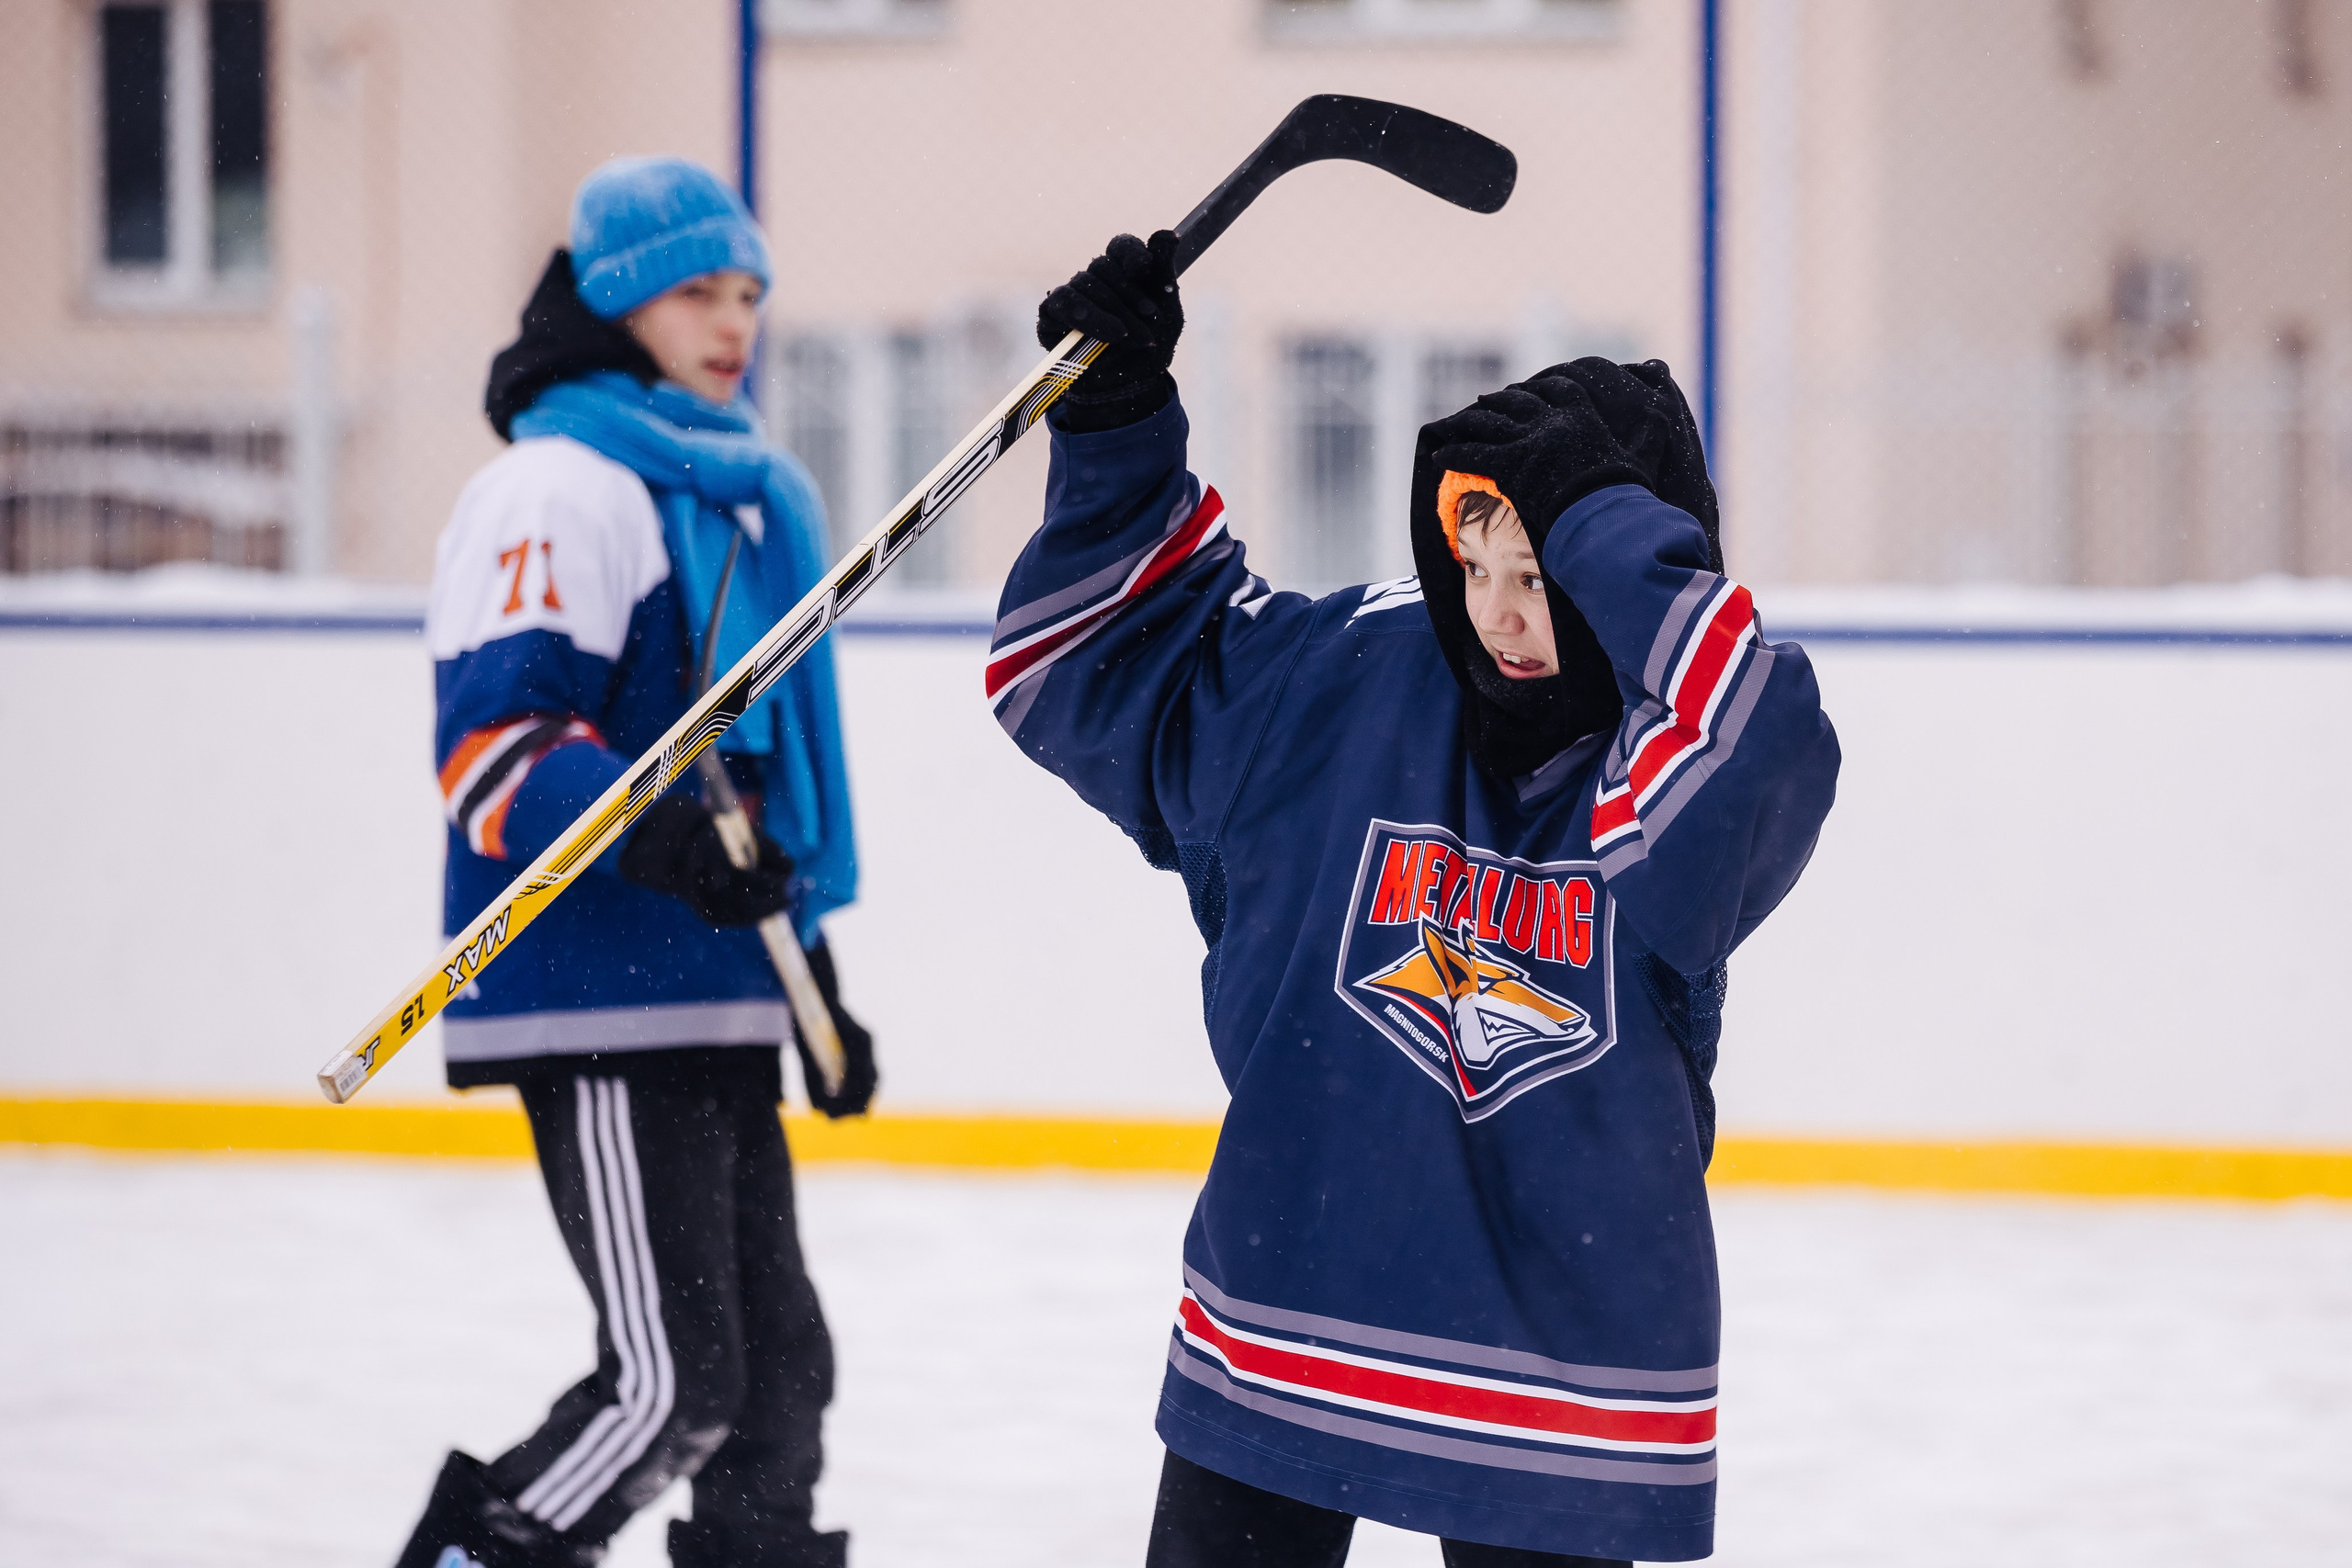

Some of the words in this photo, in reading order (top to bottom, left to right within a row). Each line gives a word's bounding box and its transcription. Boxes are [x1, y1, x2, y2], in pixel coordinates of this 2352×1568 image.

[499, 537, 563, 615] 71
[745, 416, 1005, 709] STC
[443, 904, 512, 998] MAX
[1384, 1003, 1449, 1063] MAGNITOGORSK
